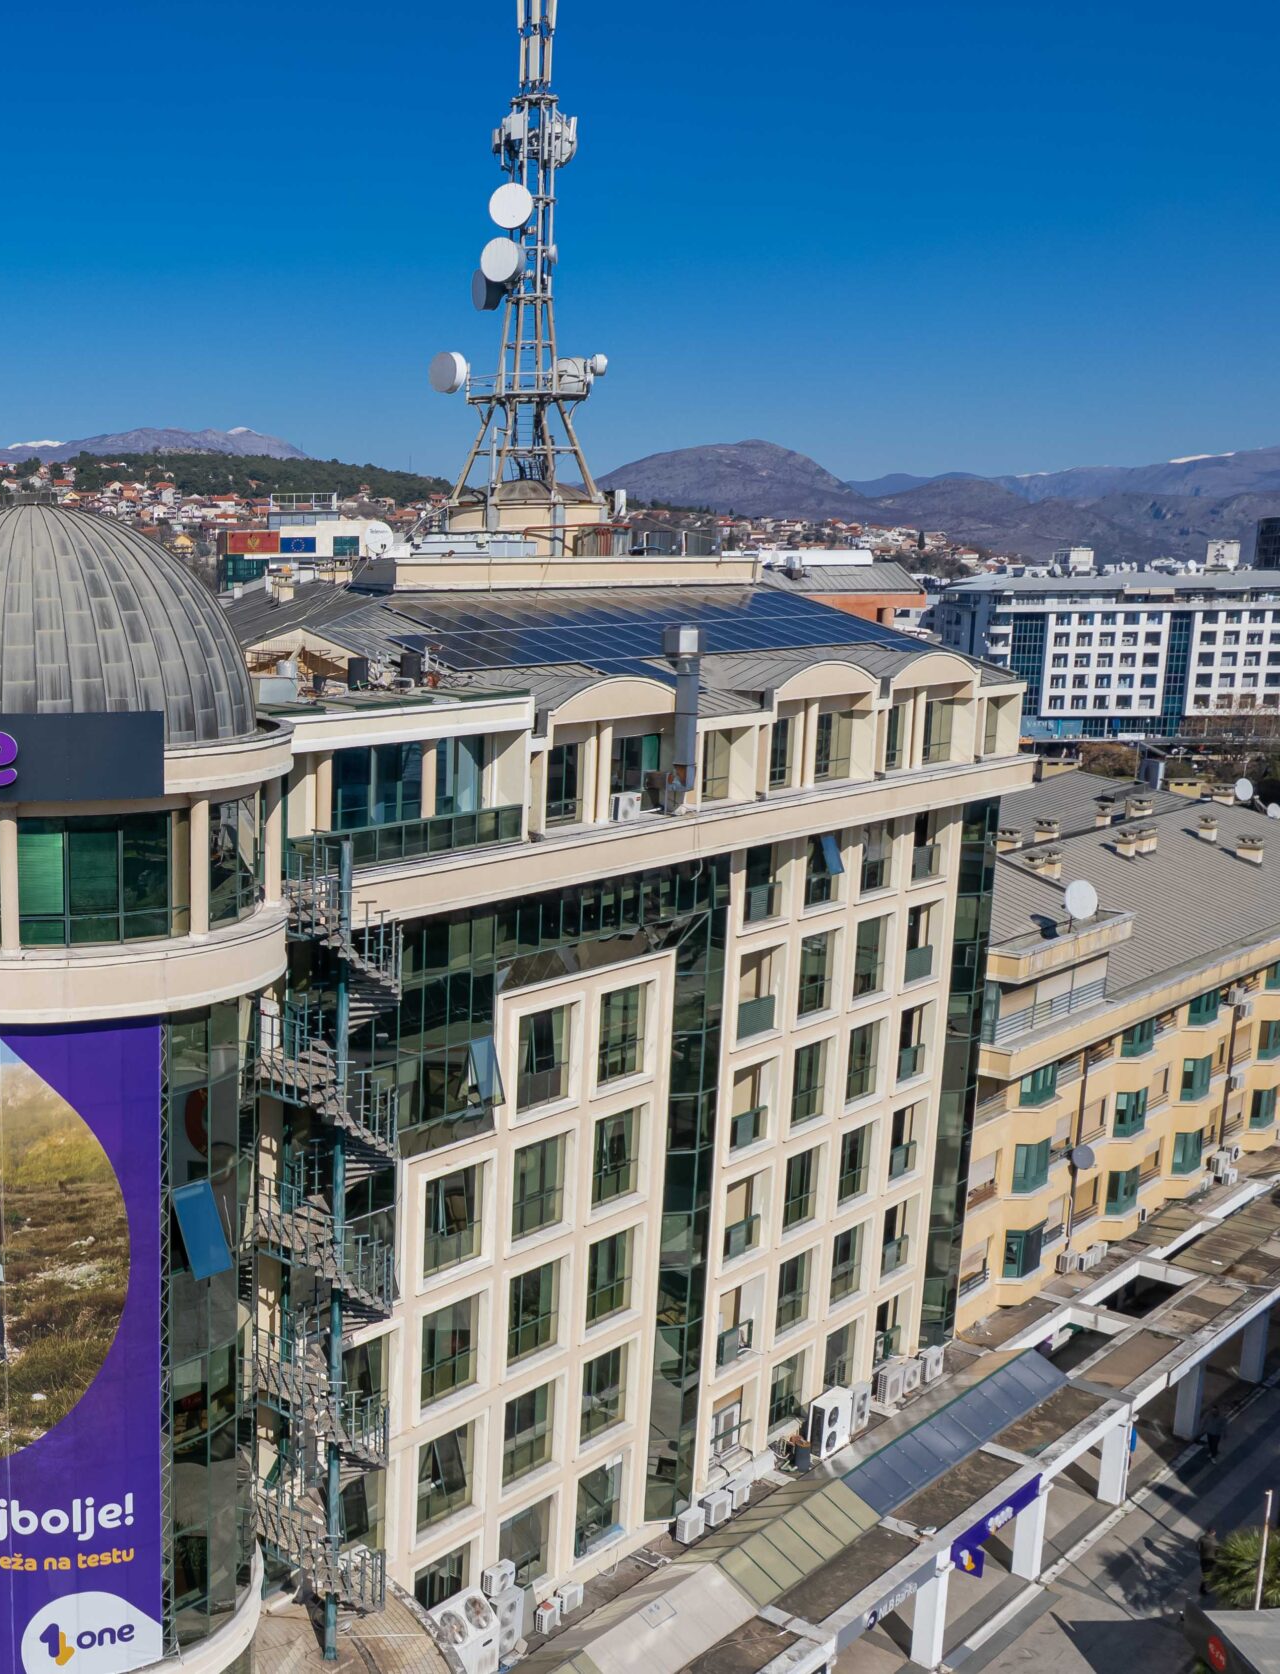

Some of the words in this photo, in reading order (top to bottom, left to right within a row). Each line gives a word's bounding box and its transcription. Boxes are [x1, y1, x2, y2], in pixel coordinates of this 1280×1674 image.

[43, 1556, 72, 1570] na
[77, 1547, 135, 1569] testu
[76, 1623, 135, 1650] one
